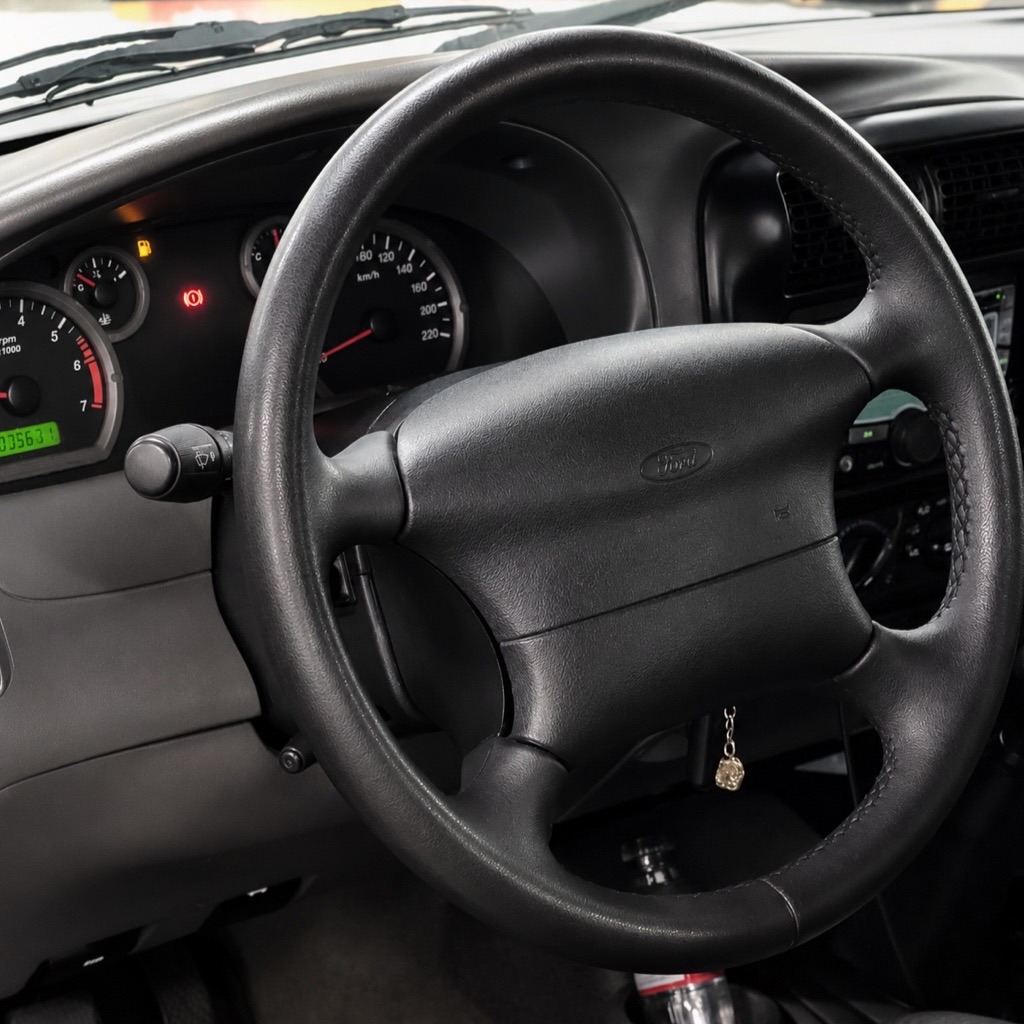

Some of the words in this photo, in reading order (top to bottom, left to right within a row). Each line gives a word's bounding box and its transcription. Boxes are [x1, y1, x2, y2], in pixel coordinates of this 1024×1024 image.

[396, 263, 413, 275] 140
[420, 303, 437, 316] 200
[18, 315, 25, 326] 4
[51, 330, 59, 342] 5
[421, 328, 439, 341] 220
[73, 360, 81, 371] 6
[80, 400, 87, 412] 7
[657, 448, 698, 476] Ford
